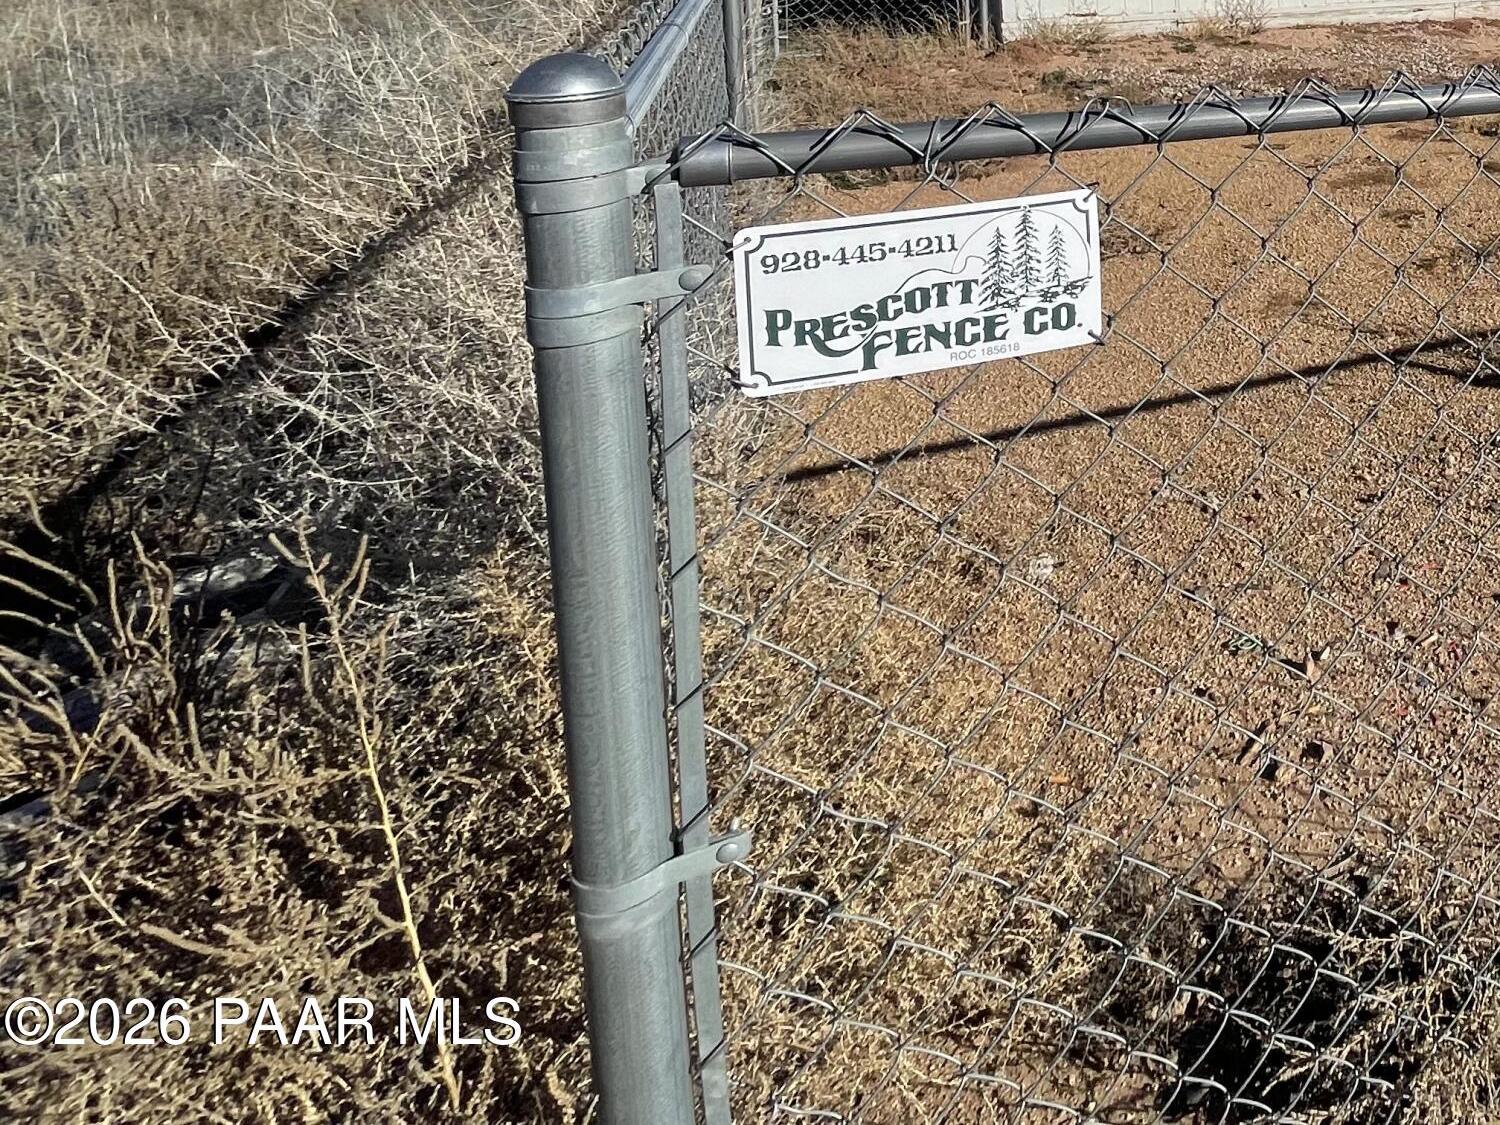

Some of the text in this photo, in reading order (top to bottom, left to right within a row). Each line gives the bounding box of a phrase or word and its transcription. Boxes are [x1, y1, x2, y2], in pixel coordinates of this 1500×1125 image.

[763, 278, 980, 357] PRESCOTT
[860, 302, 1084, 370] FENCE CO.
[949, 341, 1021, 363] ROC 185618
